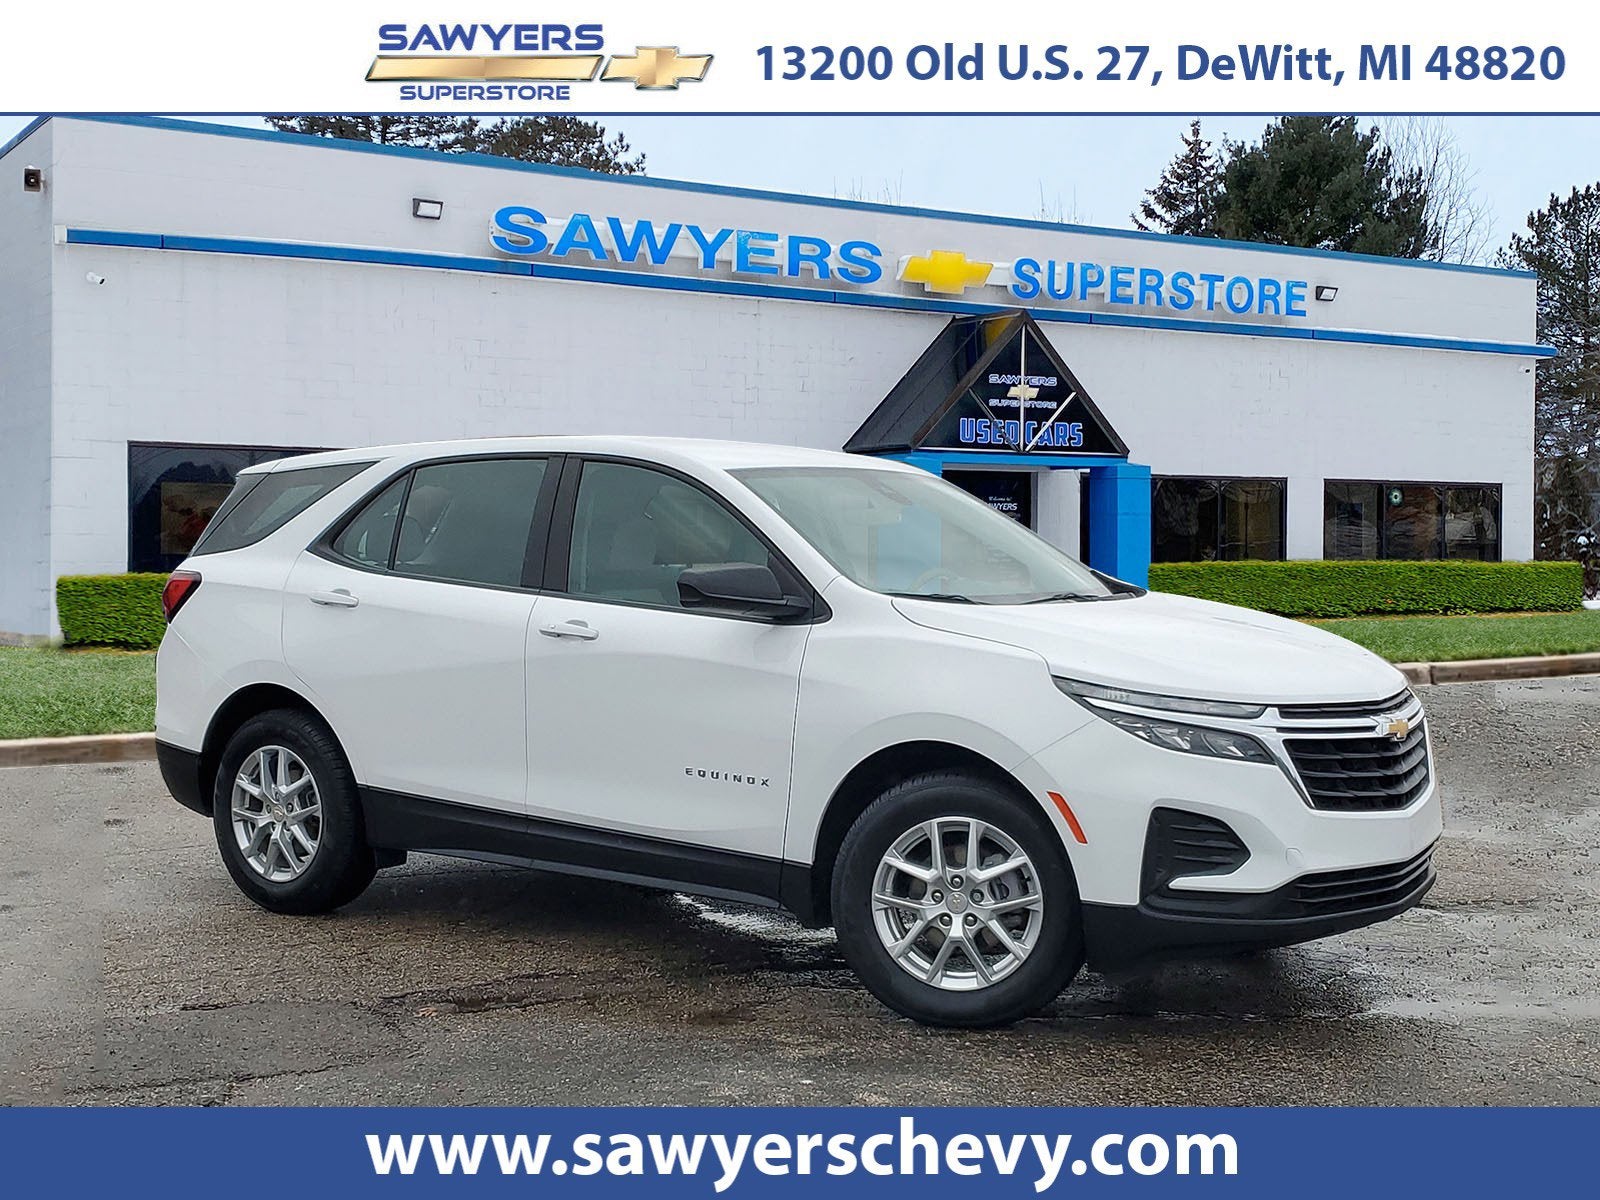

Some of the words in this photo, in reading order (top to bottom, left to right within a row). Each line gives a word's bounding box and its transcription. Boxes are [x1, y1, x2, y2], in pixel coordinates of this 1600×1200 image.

[491, 206, 883, 285] SAWYERS
[1011, 258, 1308, 317] SUPERSTORE
[988, 373, 1058, 387] SAWYERS
[960, 417, 1020, 446] USED
[1024, 420, 1084, 447] CARS
[684, 766, 770, 788] EQUINOX
